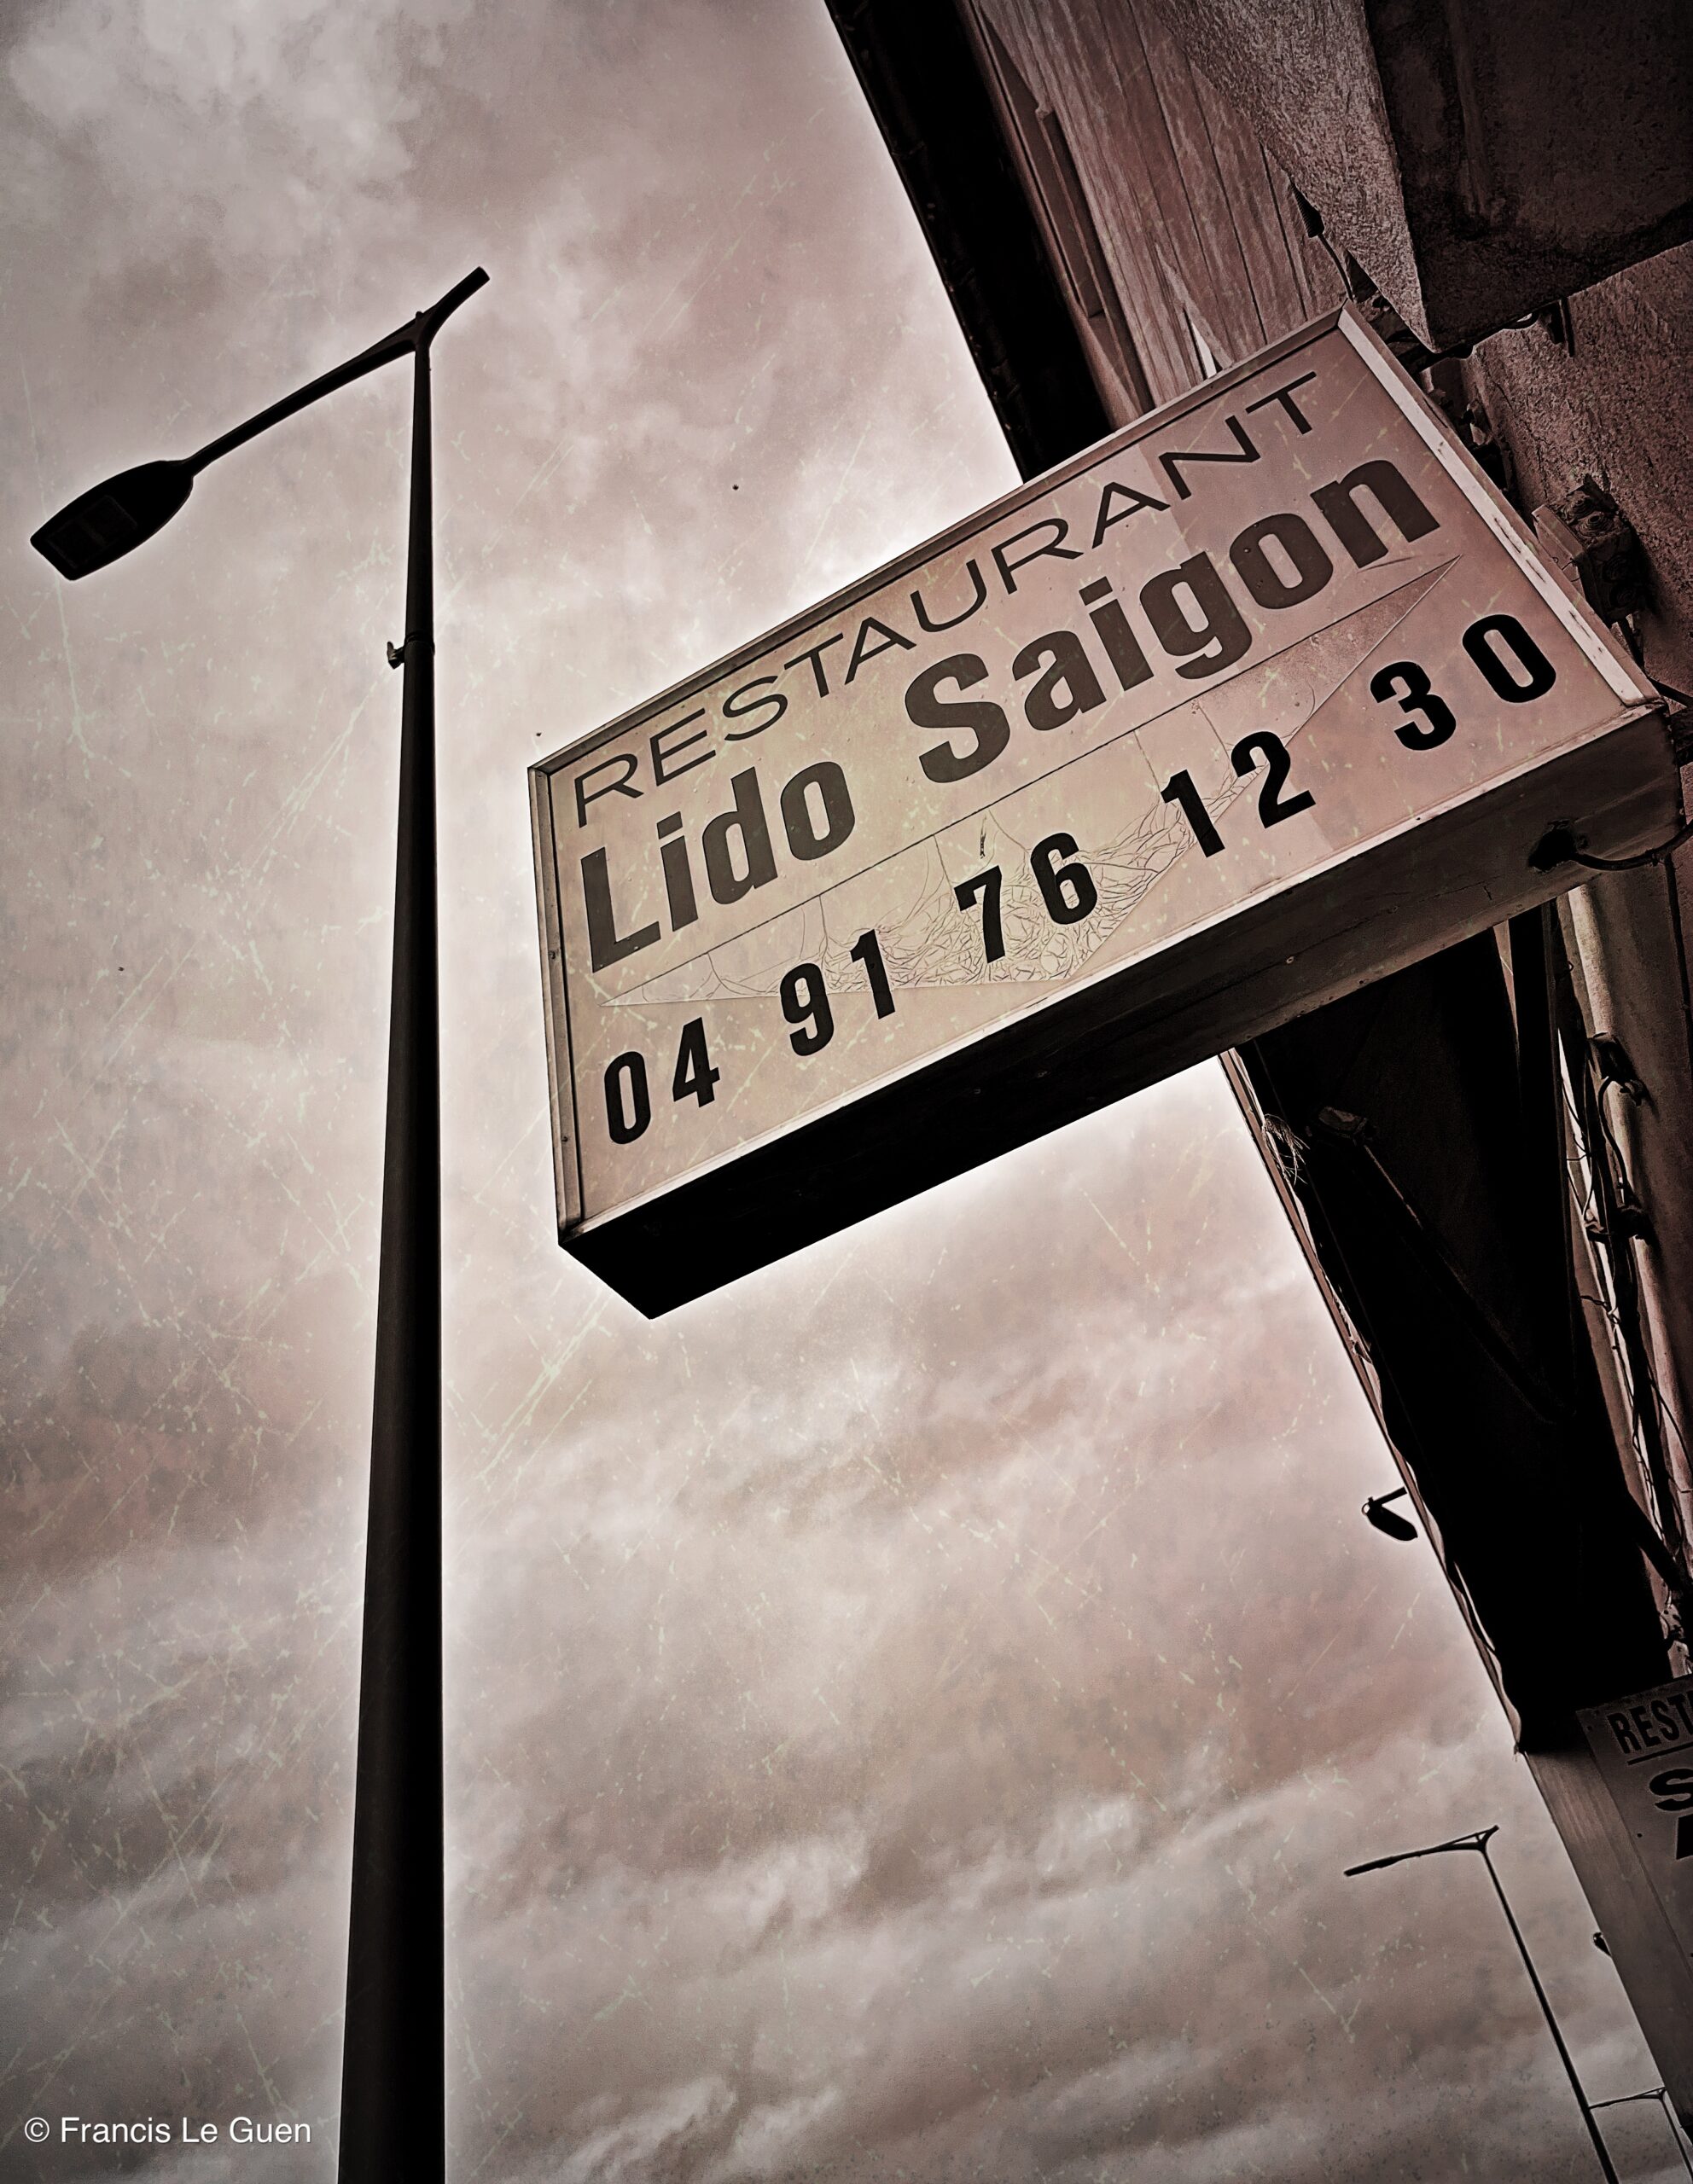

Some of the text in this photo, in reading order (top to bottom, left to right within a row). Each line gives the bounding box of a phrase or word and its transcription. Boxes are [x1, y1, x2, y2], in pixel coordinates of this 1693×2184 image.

[574, 371, 1318, 828] RESTAURANT
[580, 459, 1441, 973] Lido Saigon
[603, 613, 1557, 1145] 04 91 76 12 30
[1606, 1690, 1693, 1754] REST
